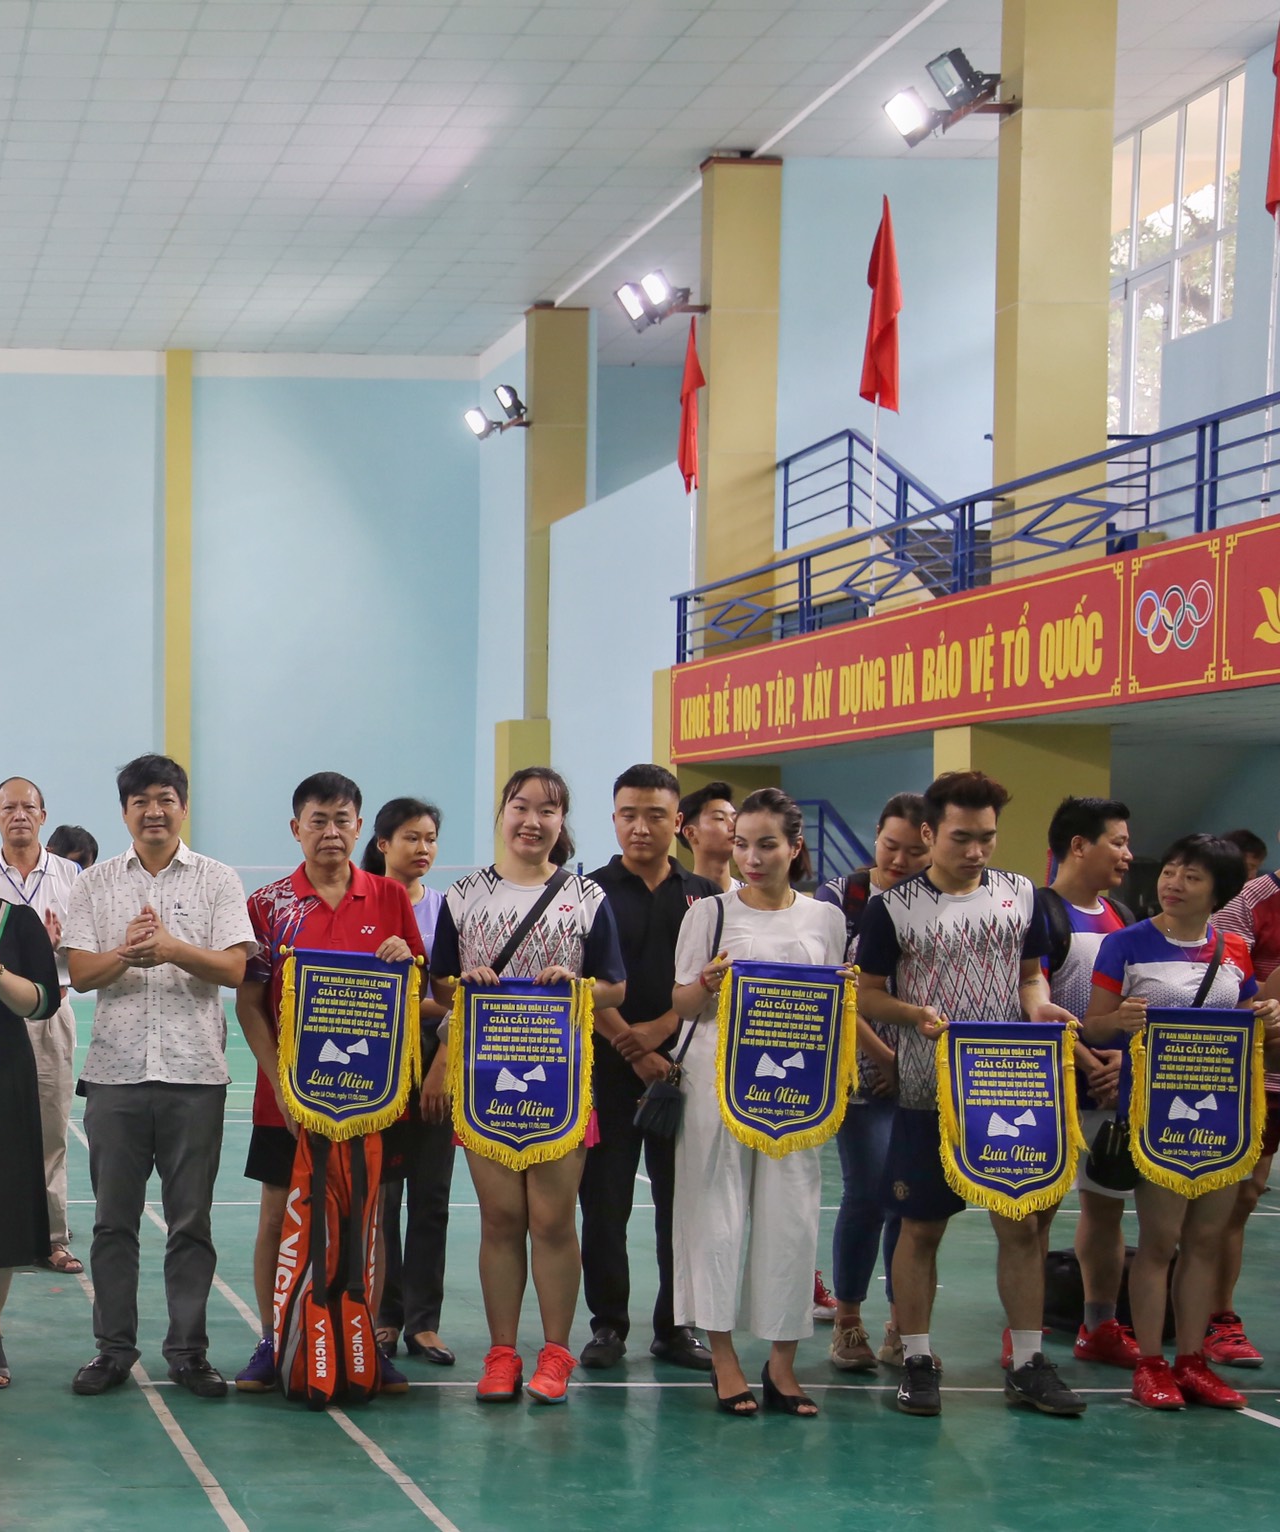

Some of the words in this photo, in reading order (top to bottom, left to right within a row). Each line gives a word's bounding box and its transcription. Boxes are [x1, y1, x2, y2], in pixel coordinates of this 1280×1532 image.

[680, 683, 710, 741] KHOẺ
[714, 673, 731, 735] ĐỂ
[733, 683, 761, 740] HỌC
[766, 670, 795, 734] TẬP,
[802, 662, 833, 722] XÂY
[839, 654, 885, 724] DỰNG
[891, 643, 915, 707] VÀ
[921, 630, 962, 702] BẢO
[969, 623, 995, 702] VỆ
[1001, 601, 1030, 688] TỔ
[1039, 594, 1103, 689] QUỐC
[318, 986, 337, 996] GIẢI
[338, 987, 357, 998] CẦU
[359, 990, 383, 1000] LÔNG
[754, 997, 774, 1008] GIẢI
[774, 999, 793, 1010] CẦU
[795, 1002, 818, 1012] LÔNG
[490, 1014, 509, 1023] GIẢI
[511, 1014, 529, 1024] CẦU
[532, 1016, 556, 1025] LÔNG
[1165, 1043, 1184, 1053] GIẢI
[1186, 1043, 1204, 1054] CẦU
[1206, 1045, 1228, 1055] LÔNG
[974, 1058, 994, 1068] GIẢI
[995, 1058, 1014, 1069] CẦU
[1016, 1060, 1040, 1069] LÔNG
[307, 1069, 333, 1086] Lưu
[338, 1072, 373, 1095] Niệm
[745, 1085, 770, 1101] Lưu
[774, 1087, 809, 1110] Niệm
[486, 1099, 512, 1115] Lưu
[517, 1100, 553, 1121] Niệm
[1159, 1127, 1184, 1143] Lưu
[1189, 1128, 1226, 1149] Niệm
[979, 1145, 1007, 1161] Lưu
[1011, 1145, 1046, 1166] Niệm
[315, 1335, 327, 1378] VICTOR
[352, 1330, 365, 1373] VICTOR
